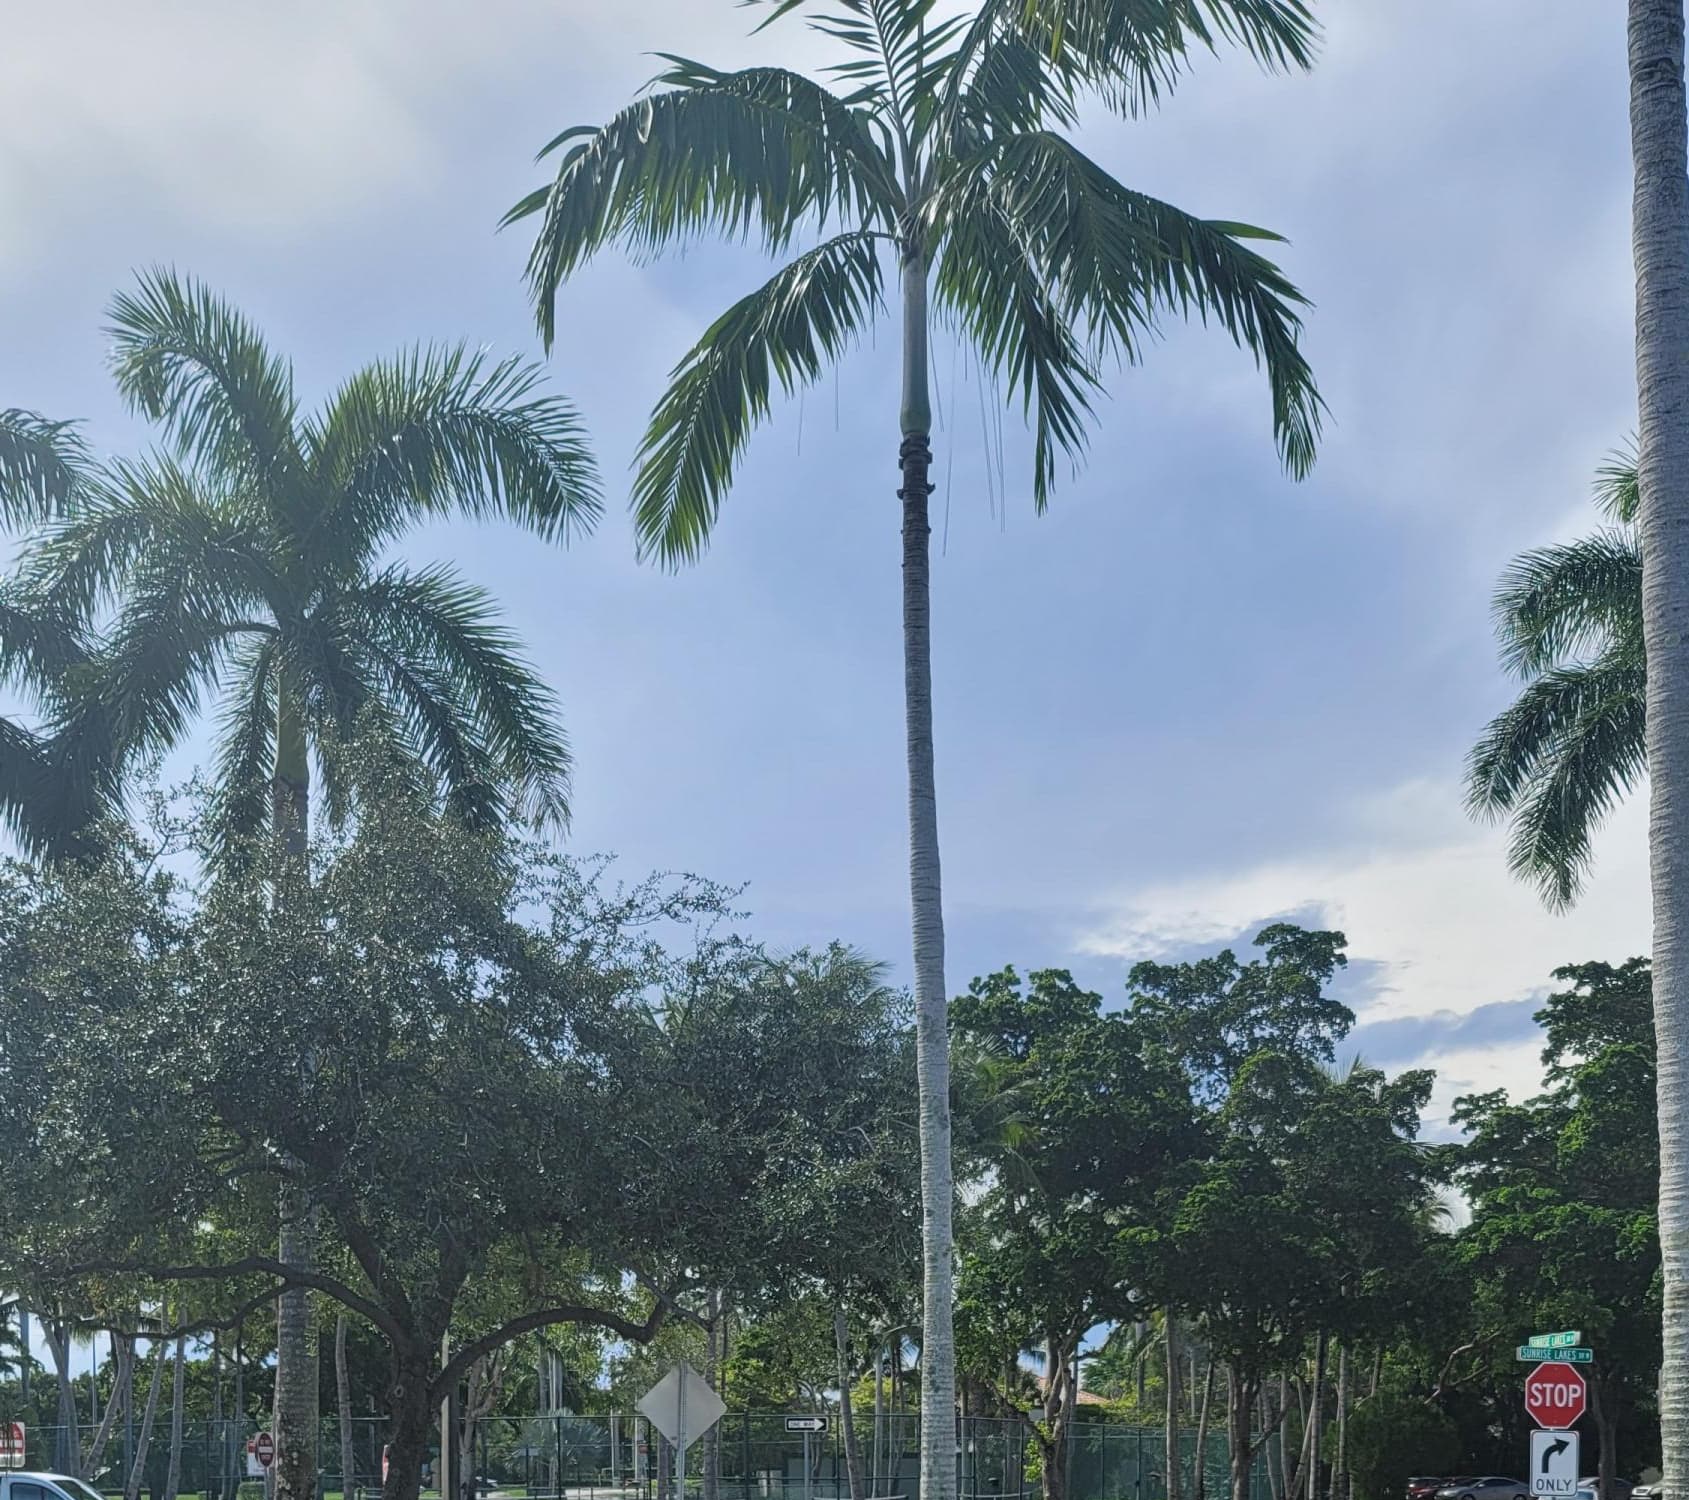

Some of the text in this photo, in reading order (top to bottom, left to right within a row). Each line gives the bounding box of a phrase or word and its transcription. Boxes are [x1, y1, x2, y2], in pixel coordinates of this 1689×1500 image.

[1522, 1348, 1552, 1359] SUNRISE
[1554, 1349, 1577, 1361] LAKES
[1530, 1383, 1581, 1408] STOP
[1536, 1478, 1572, 1491] ONLY
